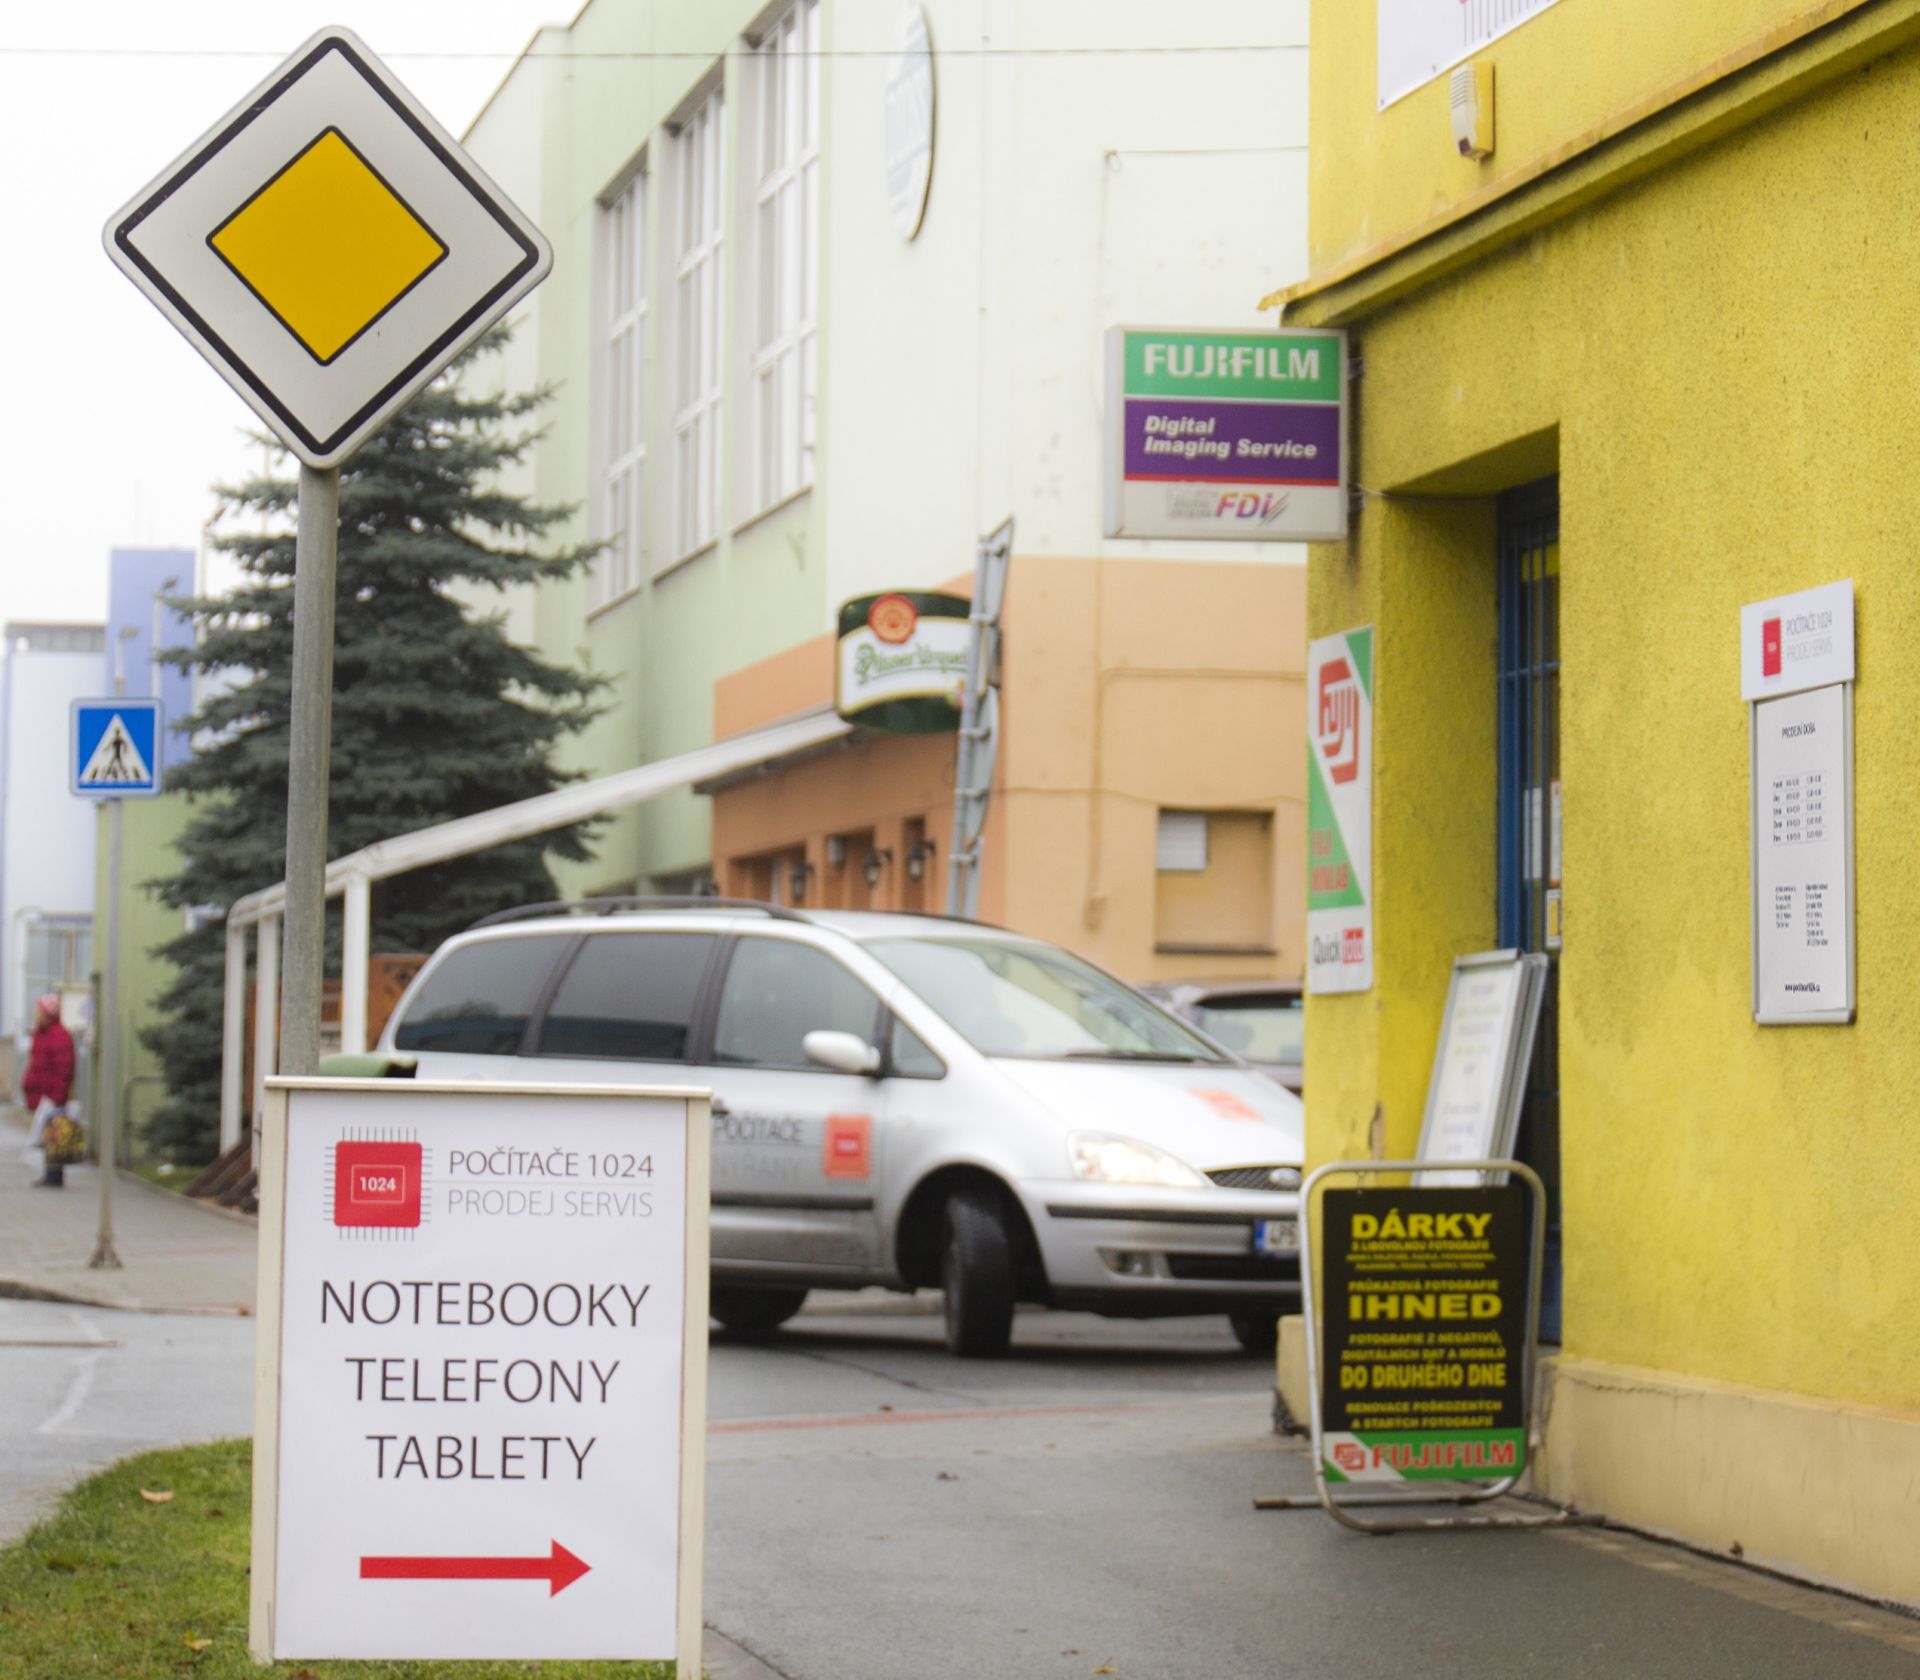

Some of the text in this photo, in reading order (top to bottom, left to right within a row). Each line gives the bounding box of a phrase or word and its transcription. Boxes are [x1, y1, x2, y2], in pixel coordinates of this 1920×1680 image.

[1143, 343, 1319, 381] FUJIFILM
[1144, 415, 1215, 437] Digital
[1144, 436, 1317, 459] Imaging Service
[1313, 933, 1341, 964] Quick
[449, 1146, 655, 1178] POČÍTAČE 1024
[359, 1175, 397, 1193] 1024
[448, 1189, 654, 1218] PRODEJ SERVIS
[1352, 1207, 1493, 1239] DÁRKY
[321, 1280, 651, 1327] NOTEBOOKY
[1349, 1293, 1502, 1321] IHNED
[345, 1357, 620, 1404] TELEFONY
[1340, 1361, 1507, 1390] DO DRUHÉHO DNE
[365, 1434, 597, 1480] TABLETY
[1371, 1440, 1517, 1470] FUJIFILM
